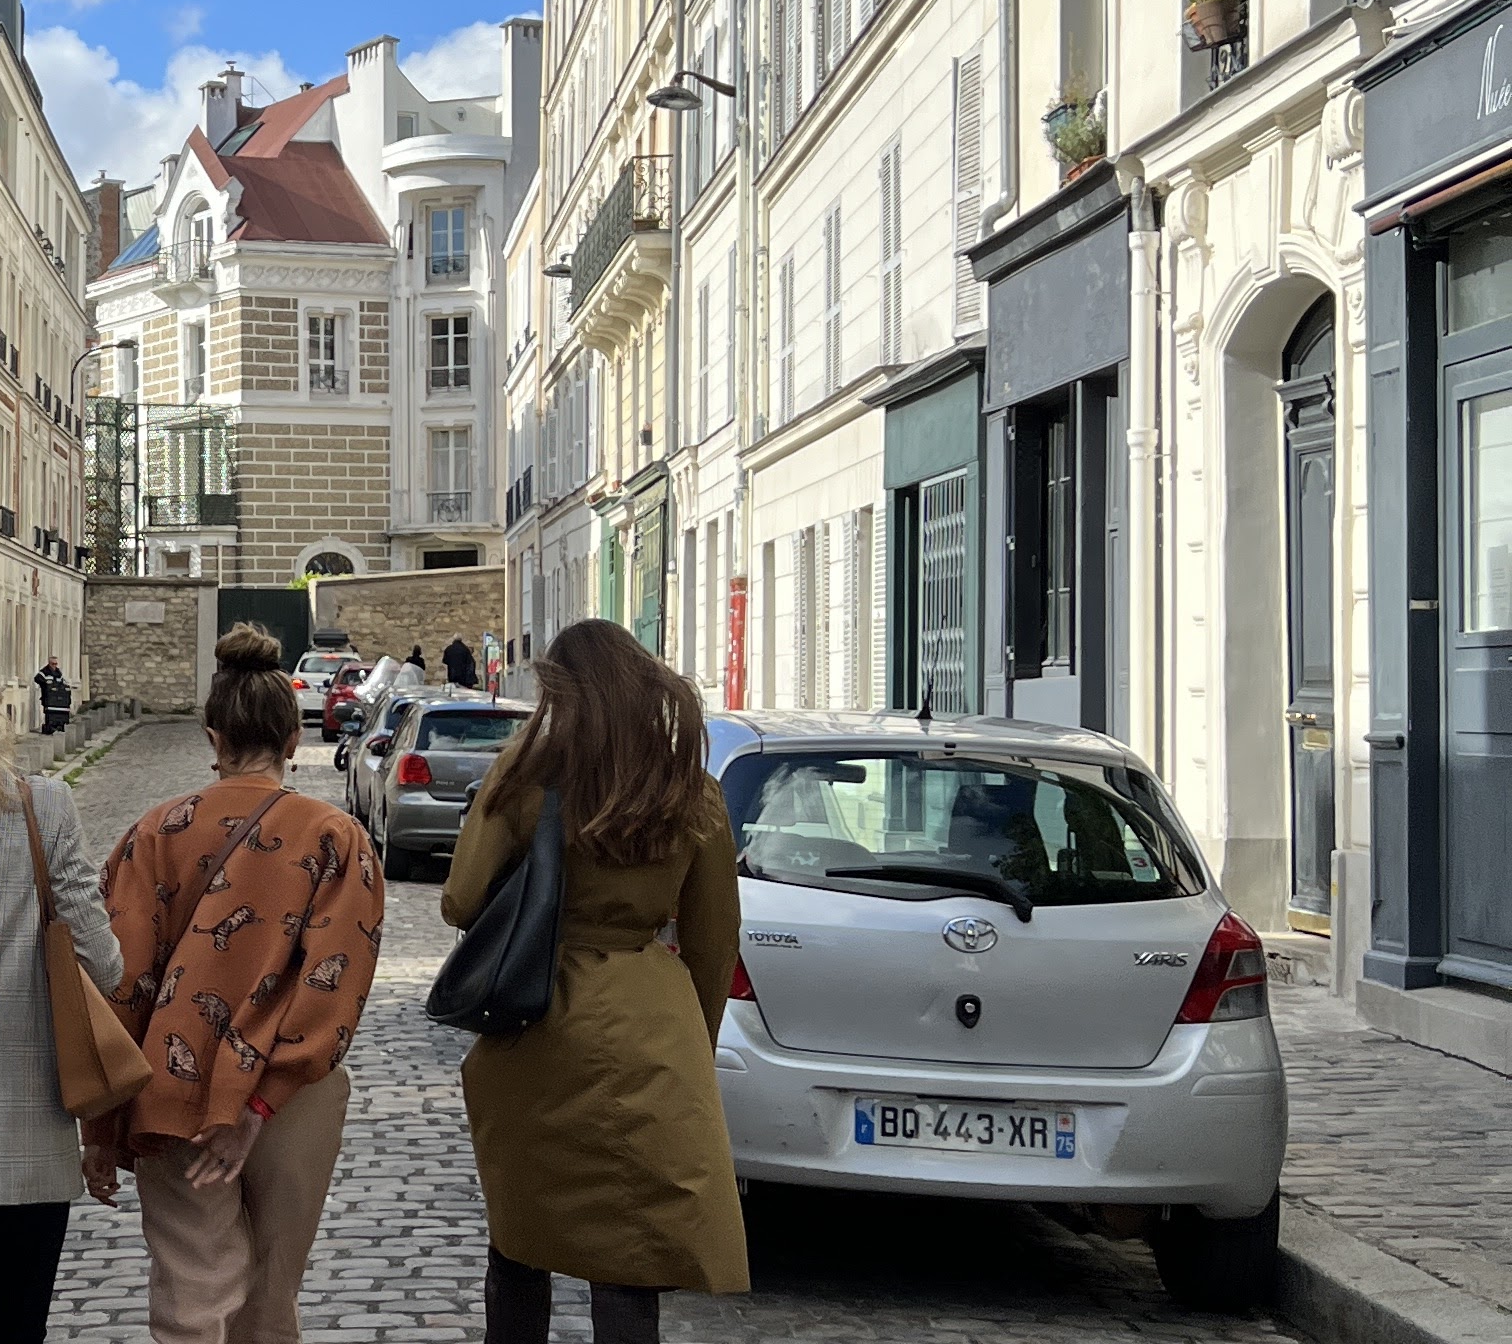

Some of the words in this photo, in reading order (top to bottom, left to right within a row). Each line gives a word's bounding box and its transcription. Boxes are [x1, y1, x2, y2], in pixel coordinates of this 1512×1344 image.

[1132, 857, 1148, 868] 3
[747, 930, 799, 944] TOYOTA
[1133, 952, 1189, 967] YARIS
[1056, 1136, 1075, 1153] 75
